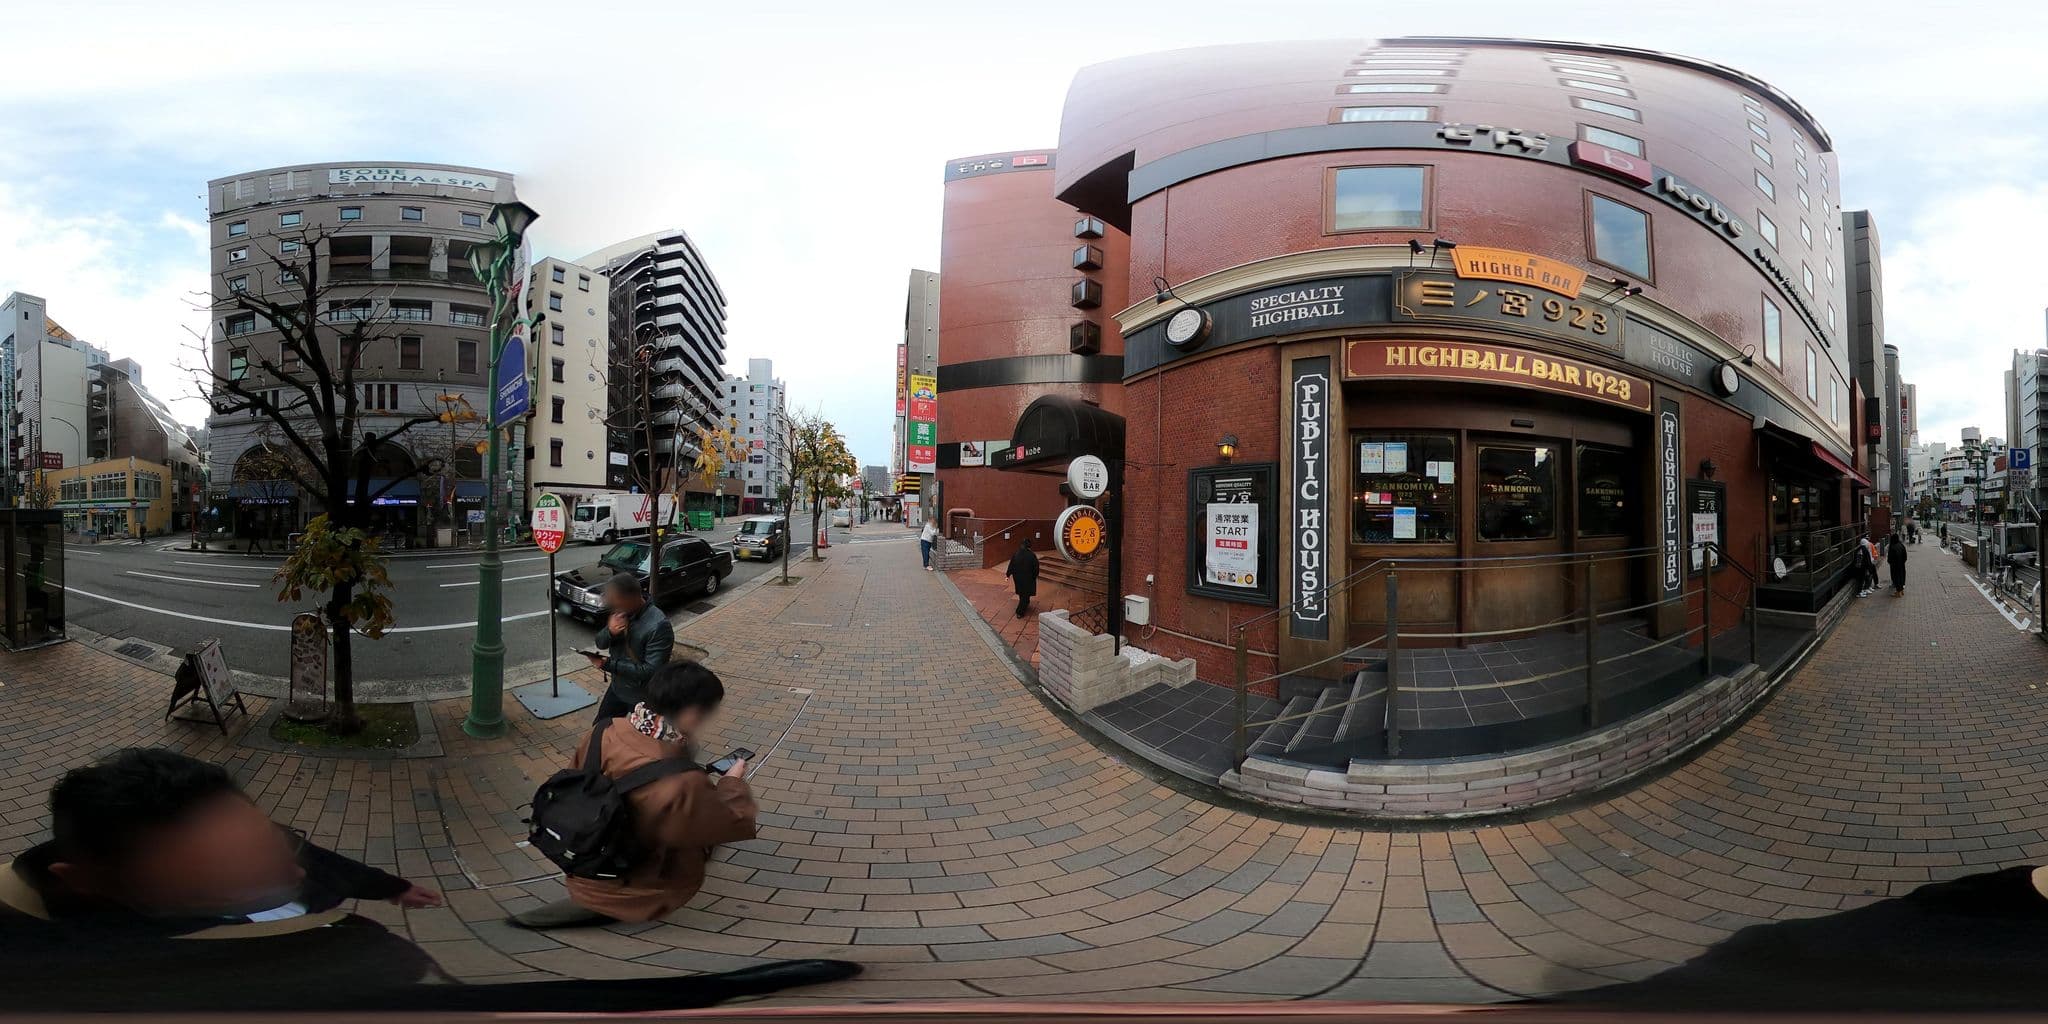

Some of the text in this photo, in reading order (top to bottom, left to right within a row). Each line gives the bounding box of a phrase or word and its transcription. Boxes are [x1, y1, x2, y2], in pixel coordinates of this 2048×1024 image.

[1603, 150, 1635, 171] b
[339, 168, 407, 176] KOBE
[339, 174, 426, 183] SAUNA
[447, 178, 488, 189] SPA
[1251, 285, 1345, 311] SPECIALTY
[1421, 280, 1534, 318] 三ノ宮
[1251, 303, 1345, 328] HIGHBALL
[1649, 334, 1693, 362] PUBLIC
[1651, 350, 1693, 377] HOUSE
[1585, 369, 1631, 401] 1923
[1005, 453, 1016, 461] the
[2015, 450, 2026, 467] P
[1663, 419, 1677, 535] HIGHBALL
[1083, 482, 1100, 490] BAR
[1375, 482, 1435, 491] SANNOMIYA
[1492, 484, 1542, 493] SANNOMIYA
[1300, 383, 1321, 611] PUBLIC HOUSE
[1064, 508, 1106, 540] HIGHBALL BAR
[1215, 513, 1249, 524] 通常営業
[535, 531, 562, 540] タクシー
[1074, 527, 1096, 538] 三ノ宮
[1215, 526, 1249, 536] START
[1697, 533, 1713, 541] START
